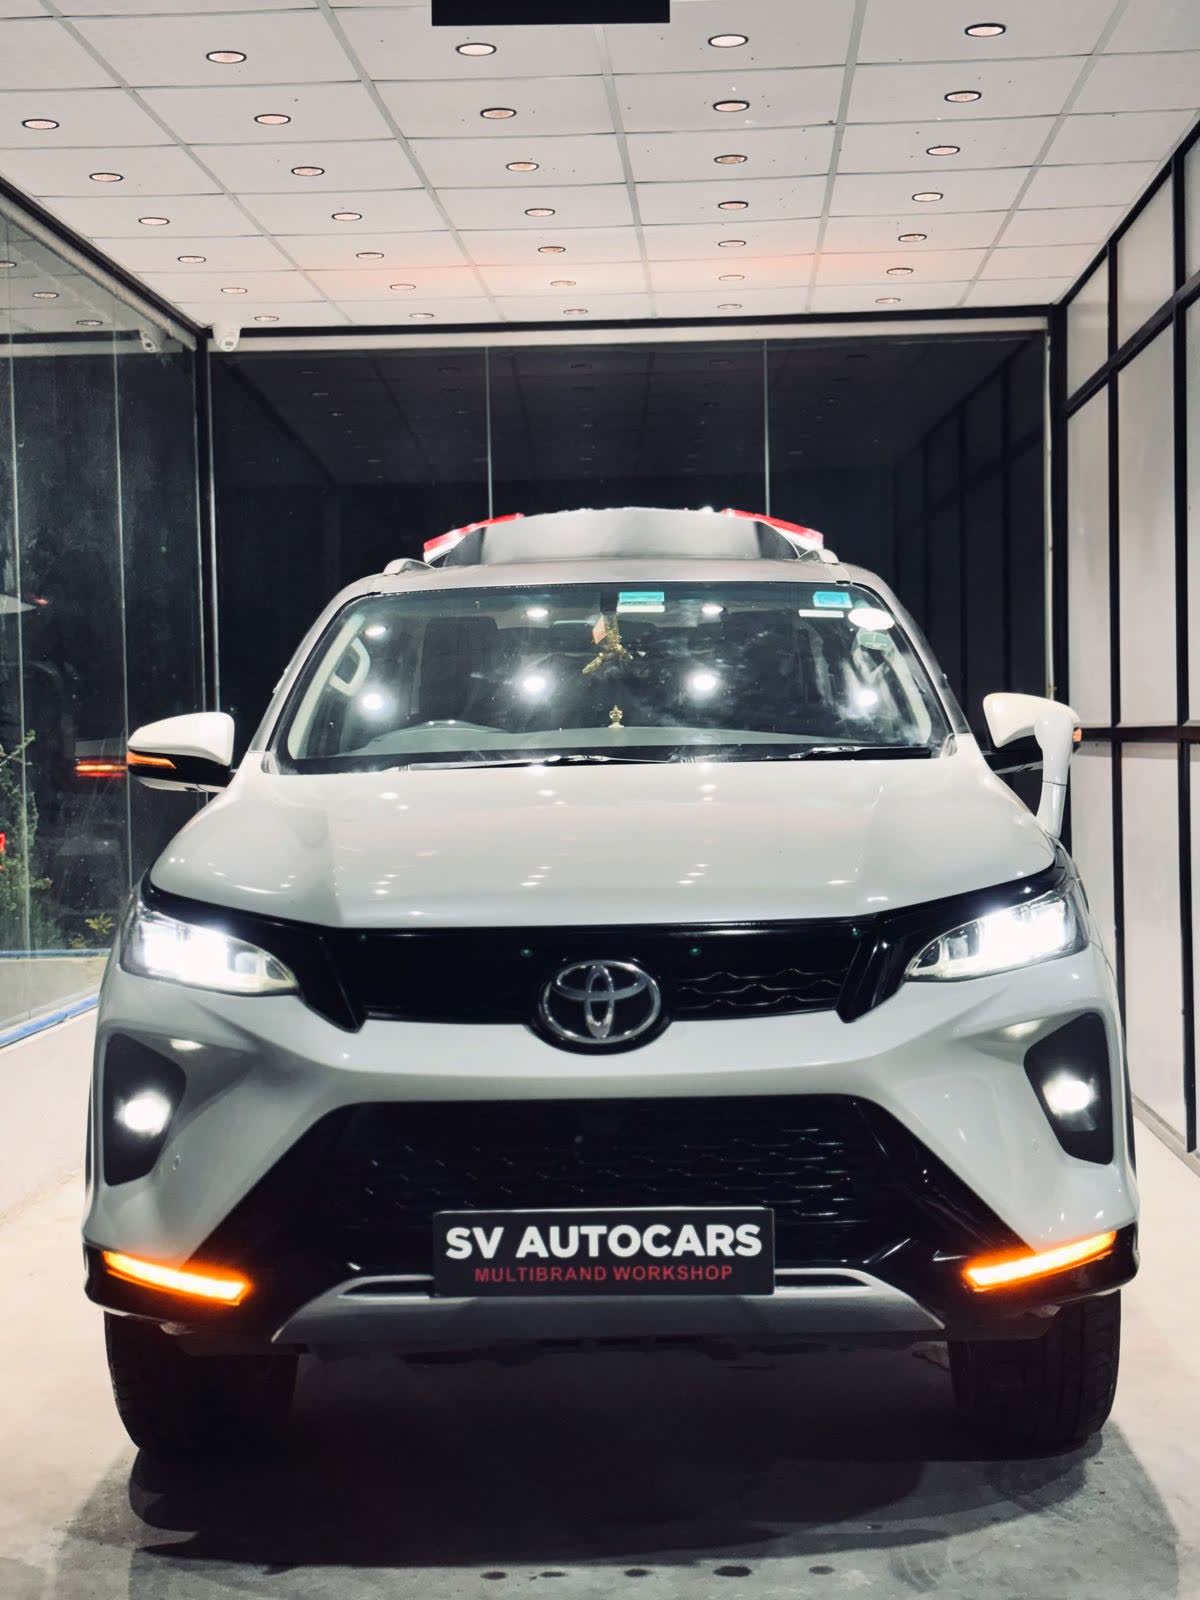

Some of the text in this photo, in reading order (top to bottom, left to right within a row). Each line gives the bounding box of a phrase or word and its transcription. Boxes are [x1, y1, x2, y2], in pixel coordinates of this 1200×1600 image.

[445, 1224, 762, 1259] SV AUTOCARS
[475, 1265, 733, 1283] MULTIBRAND WORKSHOP
